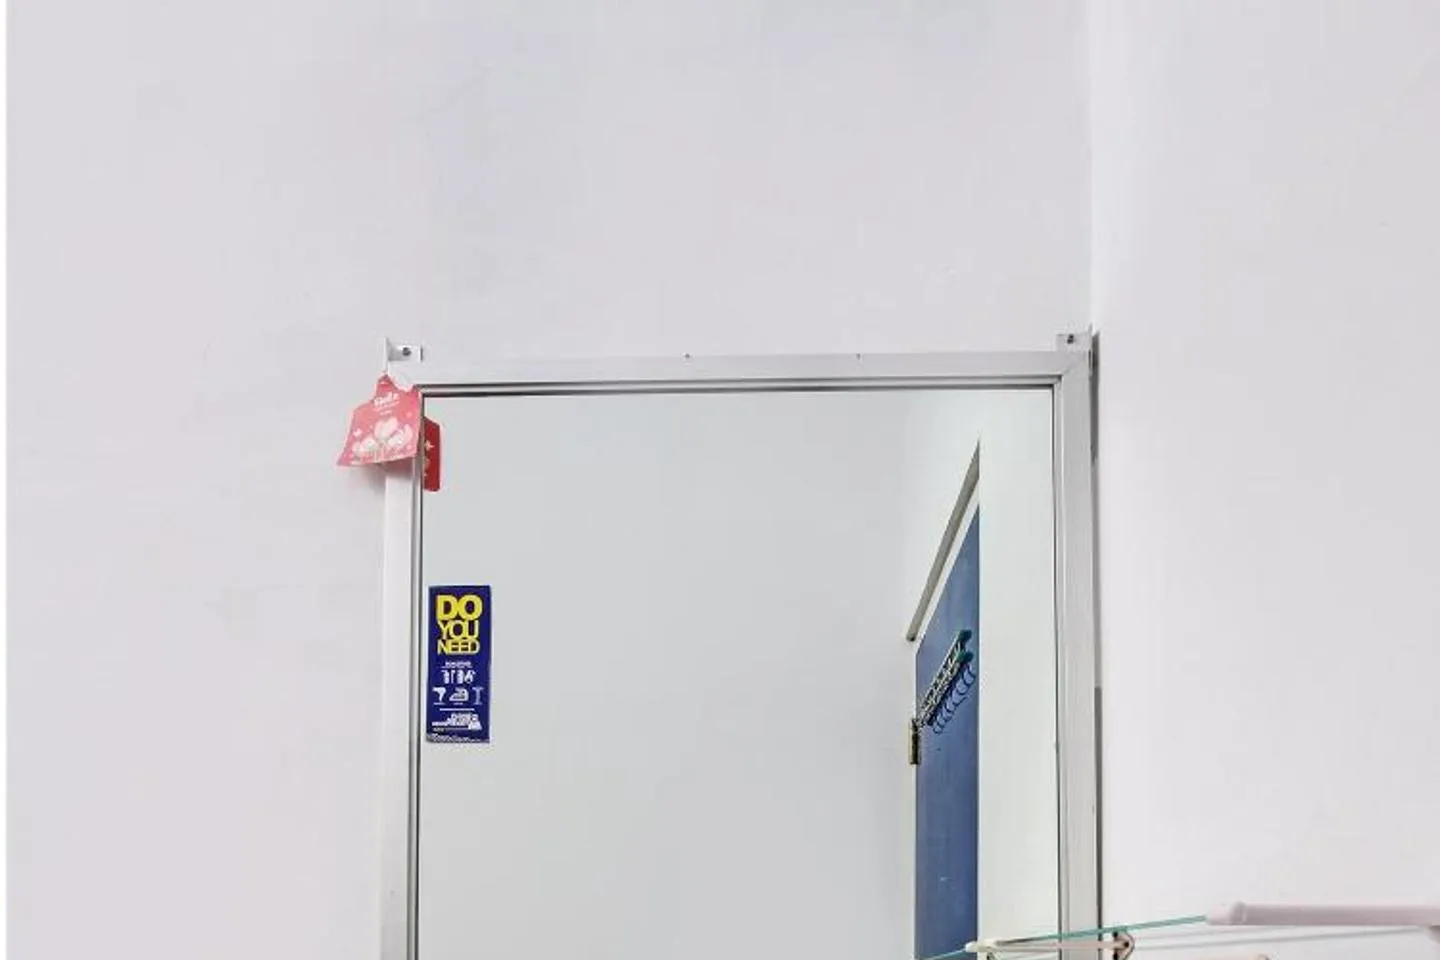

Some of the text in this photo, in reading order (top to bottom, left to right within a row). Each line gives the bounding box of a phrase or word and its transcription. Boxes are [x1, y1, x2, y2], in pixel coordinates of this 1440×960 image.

[436, 594, 483, 621] DO
[437, 620, 480, 640] YOU
[437, 639, 480, 656] NEED
